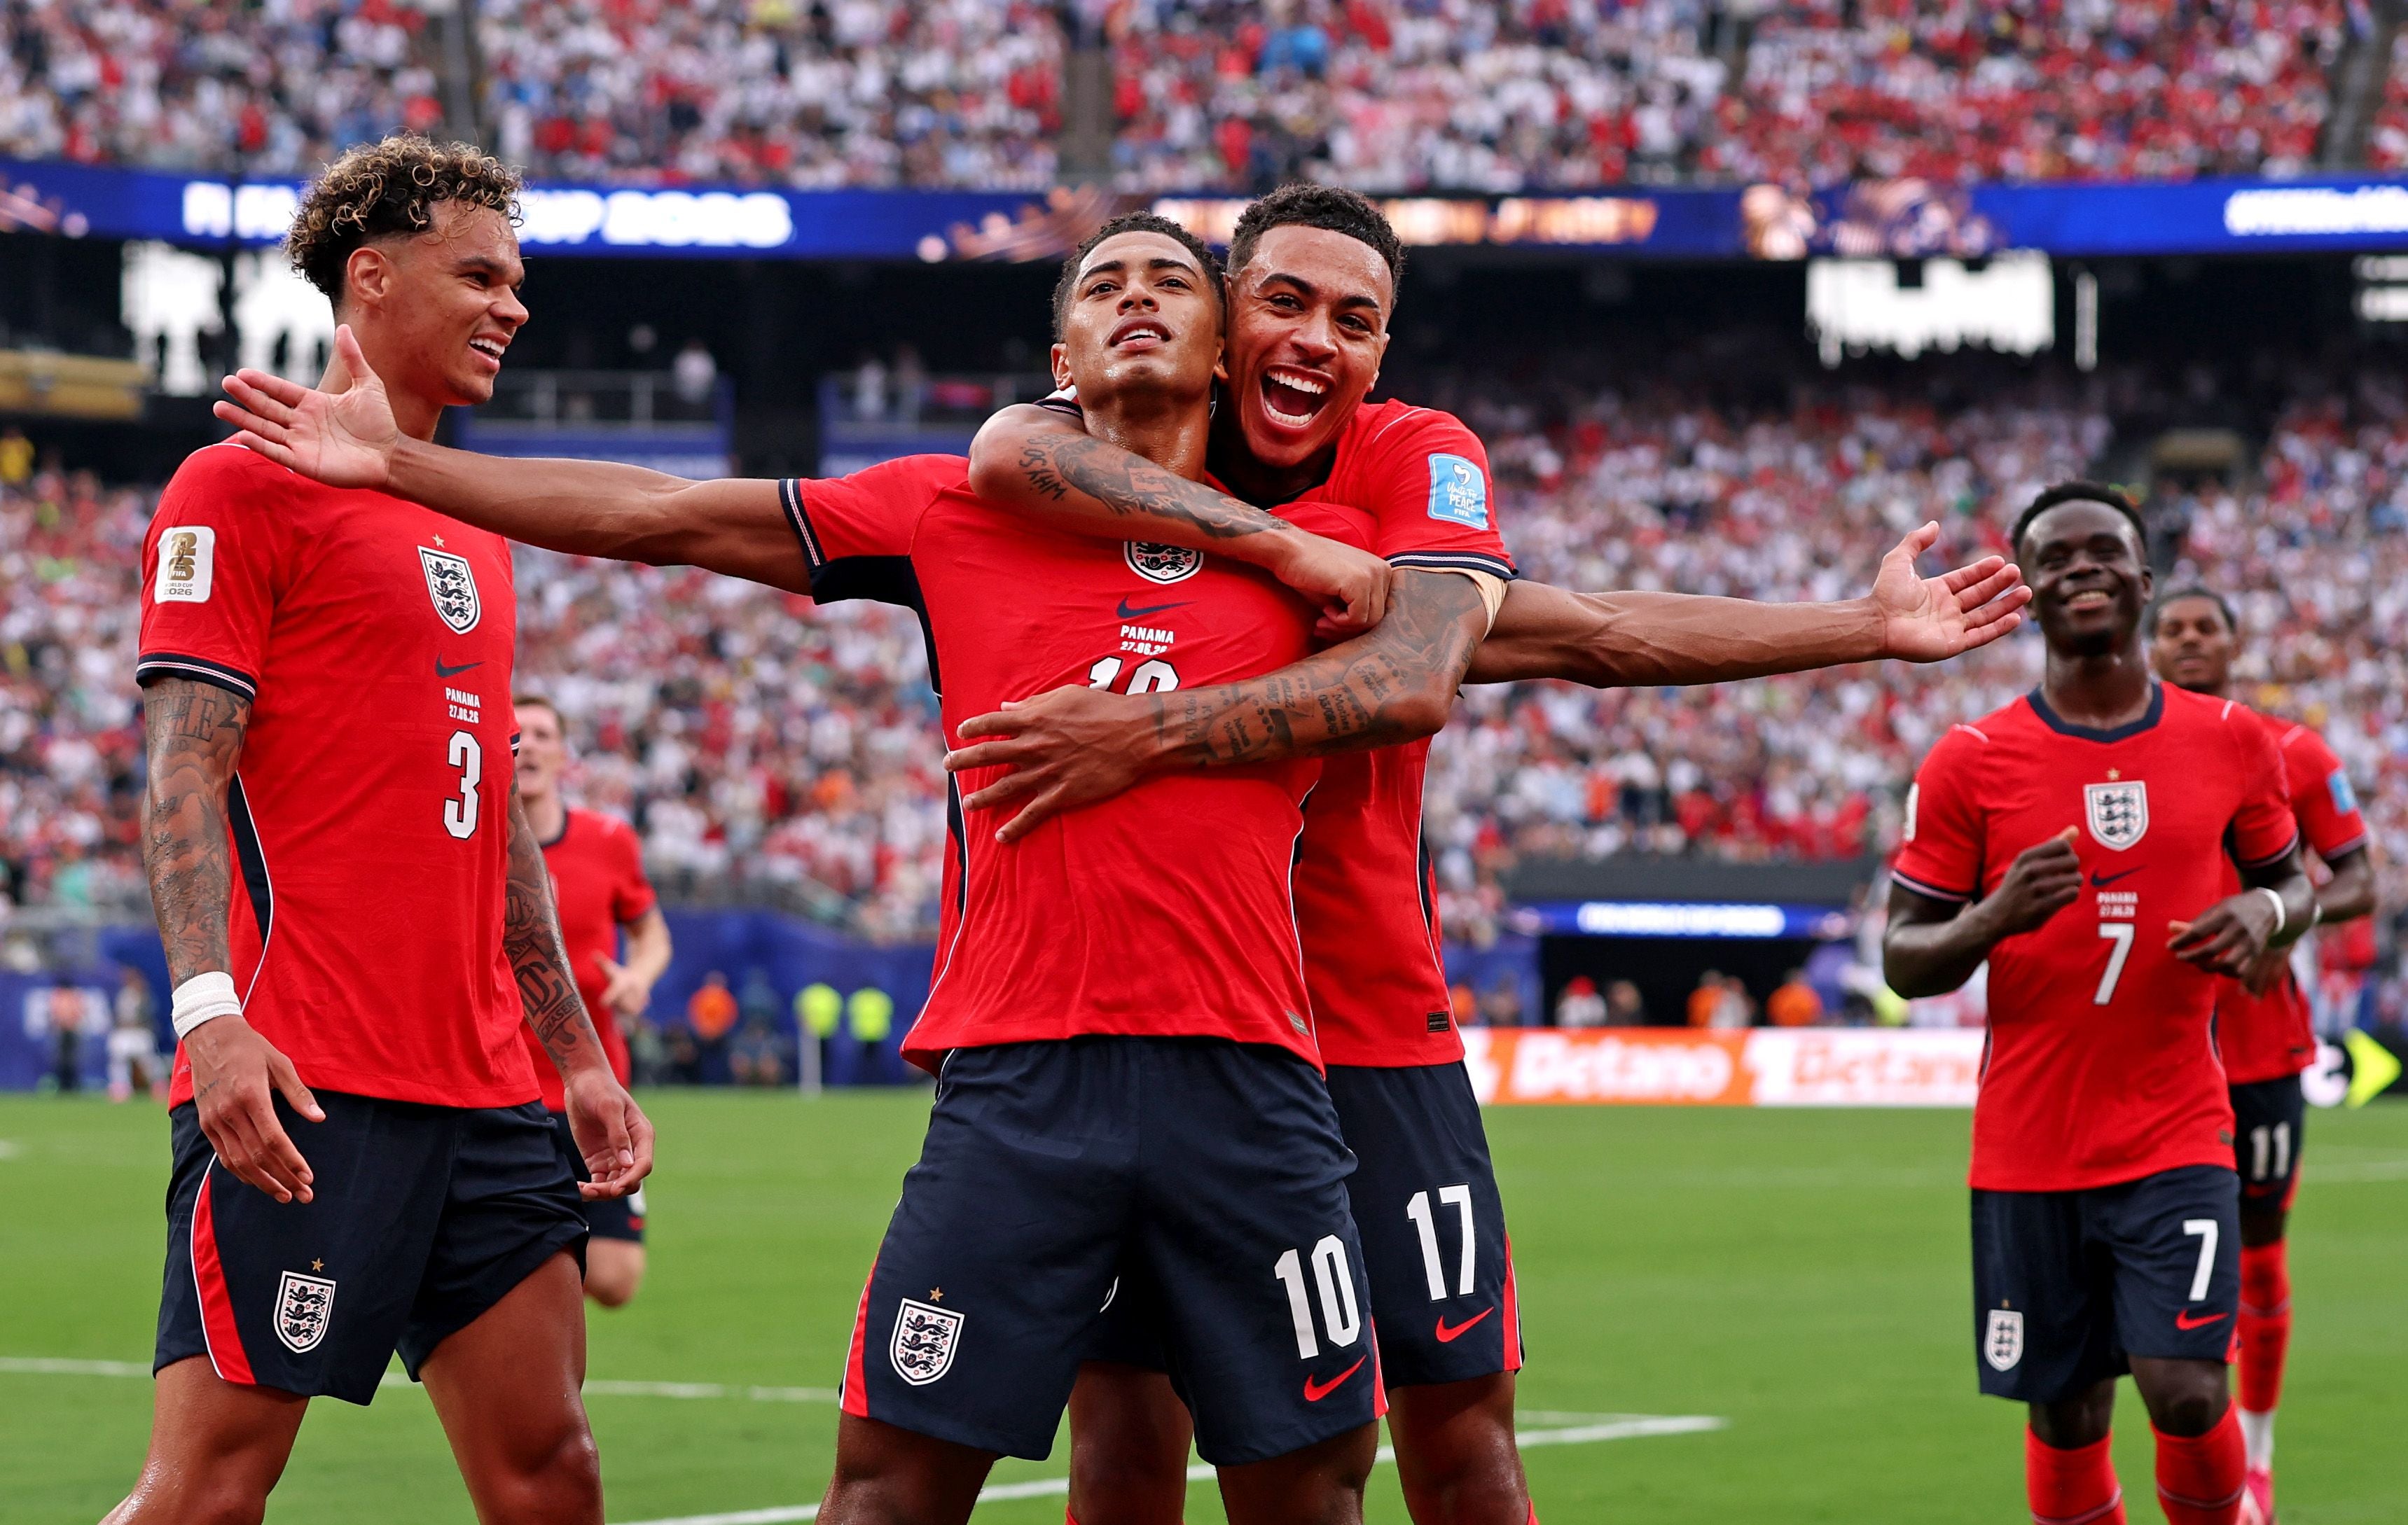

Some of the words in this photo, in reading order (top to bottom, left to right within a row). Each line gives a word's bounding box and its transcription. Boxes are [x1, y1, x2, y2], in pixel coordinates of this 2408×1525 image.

[1448, 494, 1476, 512] PEACE
[1454, 508, 1470, 518] FIFA
[1120, 625, 1174, 644] PANAMA
[445, 687, 481, 709] PANAMA
[449, 704, 479, 724] 27.06.26
[443, 729, 481, 840] 3
[2093, 923, 2136, 1006] 7
[2250, 1120, 2292, 1182] 11
[1405, 1183, 1477, 1302] 17
[2182, 1218, 2219, 1302] 7
[1274, 1233, 1361, 1360] 10
